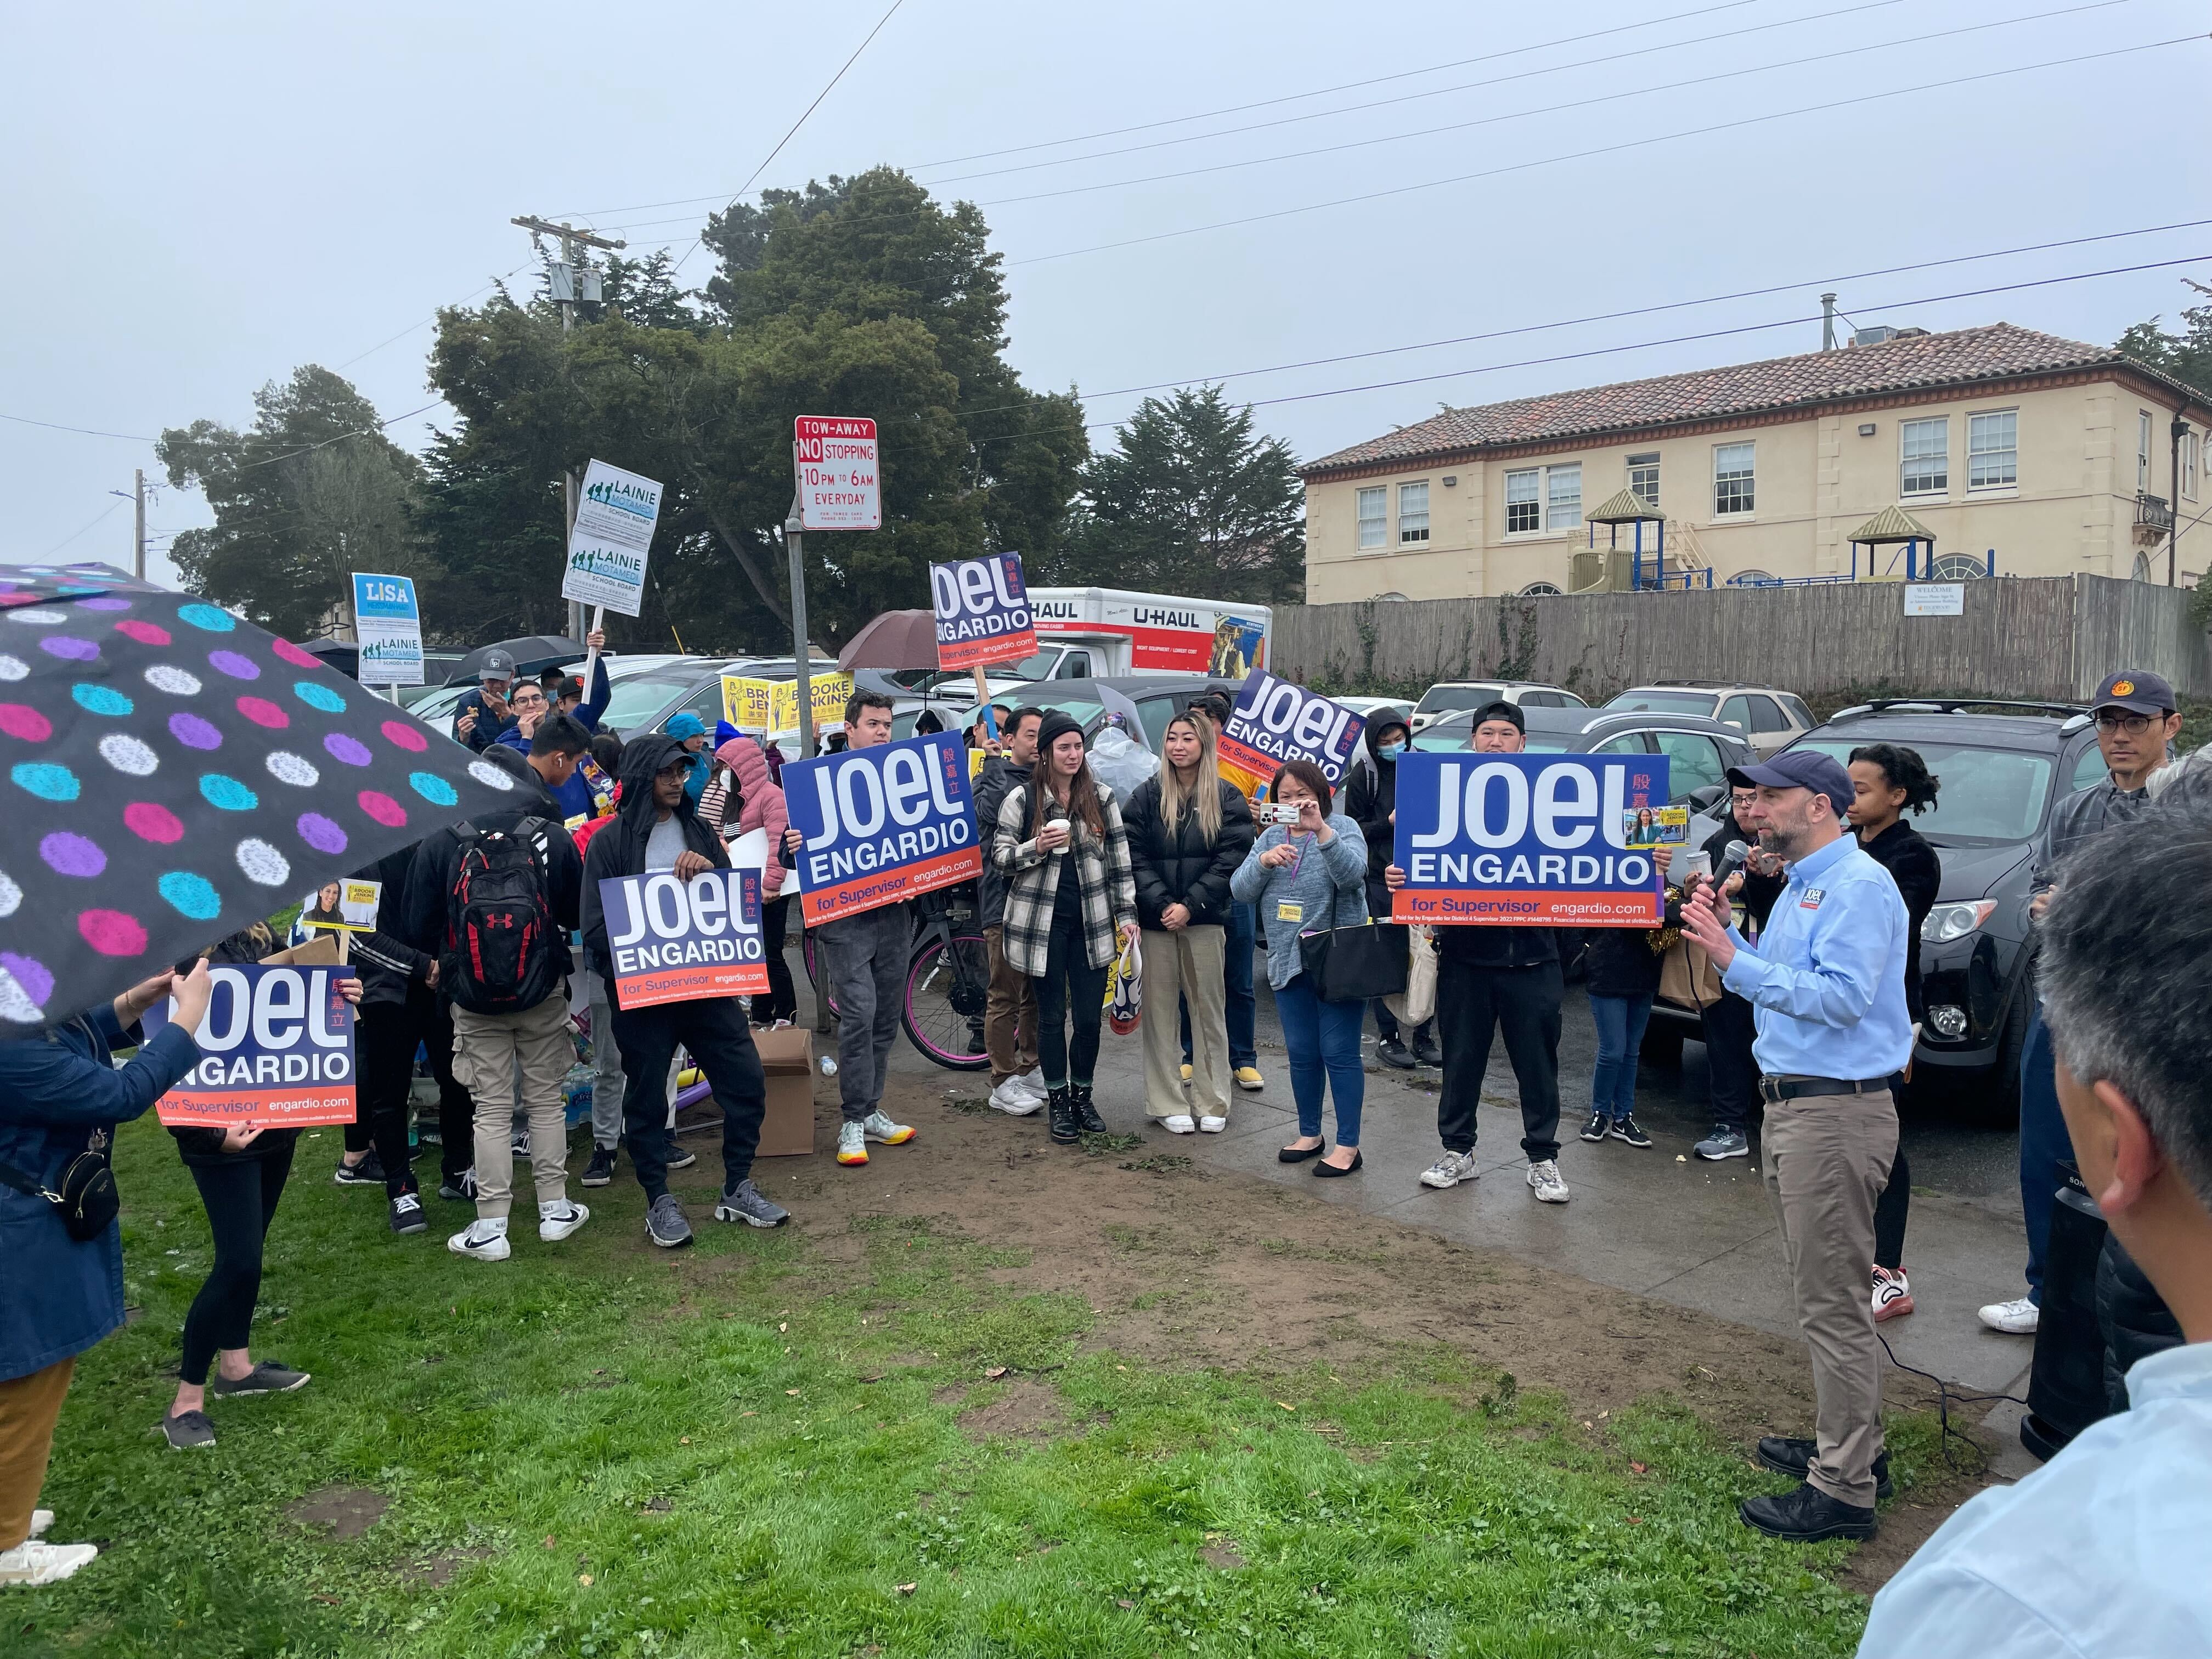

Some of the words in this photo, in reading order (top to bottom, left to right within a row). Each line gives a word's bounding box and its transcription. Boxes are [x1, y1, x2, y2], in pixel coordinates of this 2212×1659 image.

[804, 421, 868, 436] TOW-AWAY
[799, 438, 821, 459] NO
[825, 444, 873, 460] STOPPING
[611, 494, 653, 514] MOTAMEDI
[614, 481, 656, 505] LAINIE
[815, 493, 865, 505] EVERYDAY
[608, 508, 631, 520] SCHOOL
[632, 516, 650, 526] BOARD
[597, 548, 641, 571] LAINIE
[595, 562, 639, 580] MOTAMEDI
[592, 575, 617, 588] SCHOOL
[618, 582, 636, 591] BOARD
[1134, 607, 1199, 628] U-HAUL
[382, 639, 418, 649] LAINIE
[983, 637, 1033, 653] engardio.com
[1221, 741, 1232, 752] for
[1234, 748, 1276, 772] Superviso
[943, 748, 960, 795] 殷嘉立
[1633, 774, 1650, 808] 殷嘉
[809, 818, 969, 884] ENGARDIO
[1411, 853, 1650, 885] ENGARDIO
[816, 897, 837, 911] for
[839, 876, 907, 904] Supervisor
[913, 859, 972, 882] engardio.com
[745, 878, 756, 917] 殷嘉立
[1411, 898, 1437, 911] for
[1441, 898, 1541, 915] Supervisor
[1551, 902, 1646, 915] engardio.com
[616, 937, 761, 973] ENGARDIO
[623, 984, 641, 995] for
[645, 974, 709, 991] Supervisor
[715, 973, 764, 984] engardio.com
[160, 1098, 179, 1109] for
[182, 1099, 260, 1114] Supervisor
[269, 1098, 349, 1112] engardio.com
